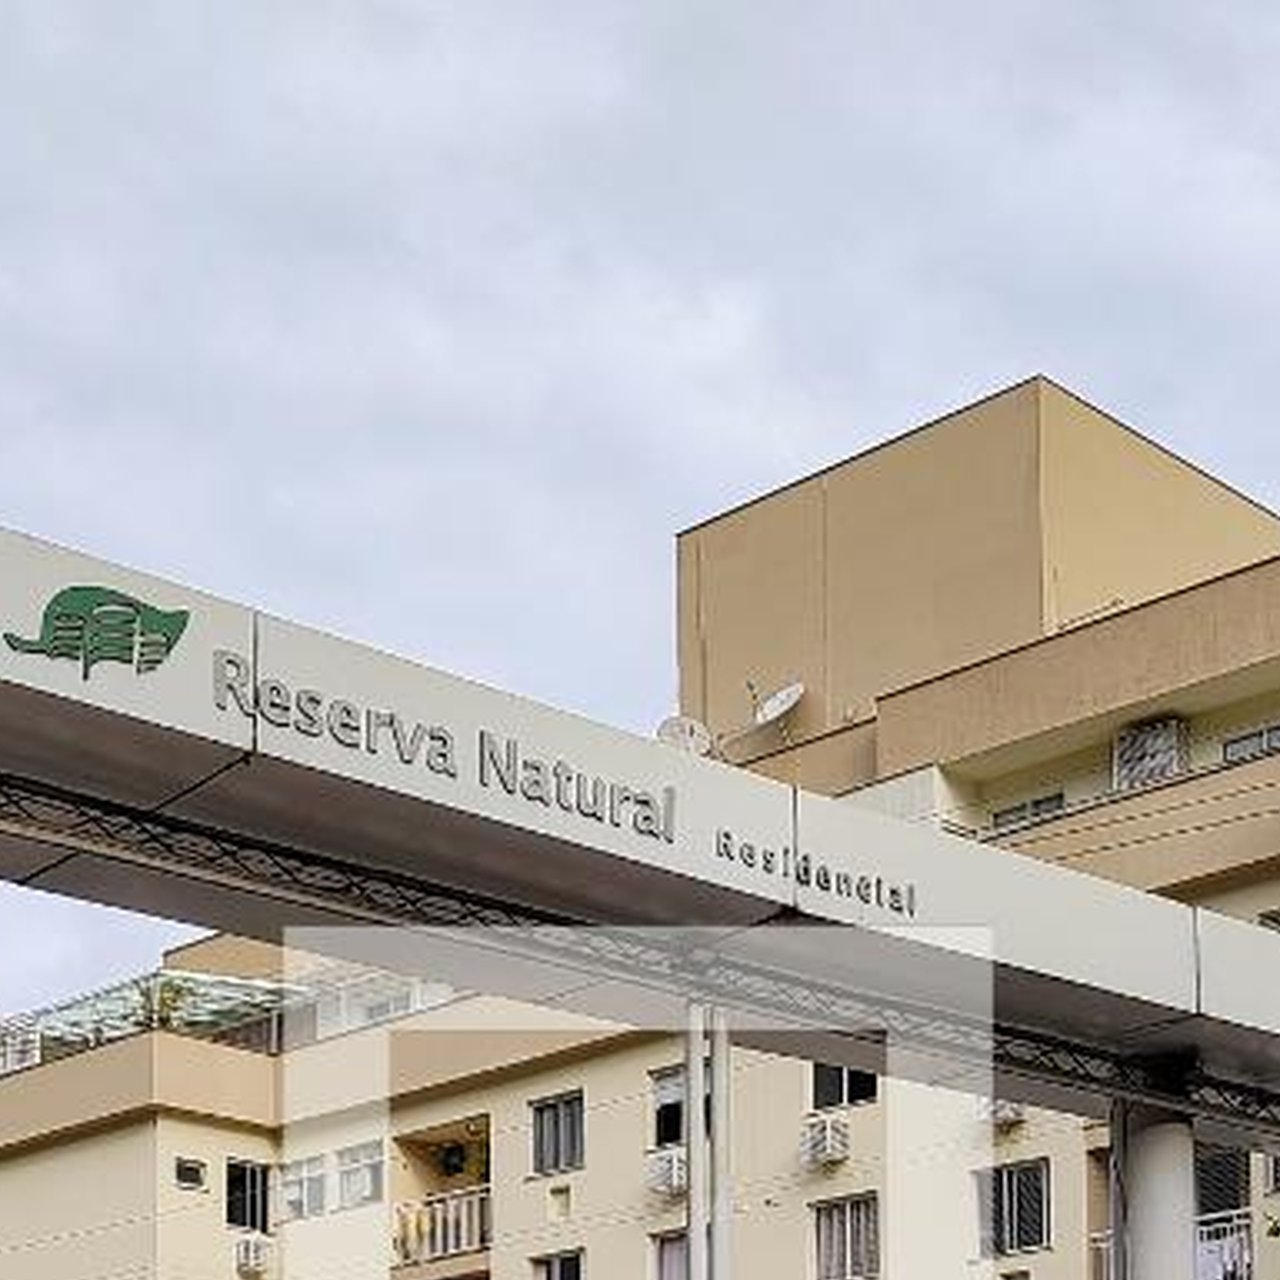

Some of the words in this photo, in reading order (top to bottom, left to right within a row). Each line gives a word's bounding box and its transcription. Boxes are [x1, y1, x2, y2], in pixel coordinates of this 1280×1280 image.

[212, 649, 458, 778] Reserva
[477, 730, 678, 845] Natural
[715, 829, 917, 917] Residencial
